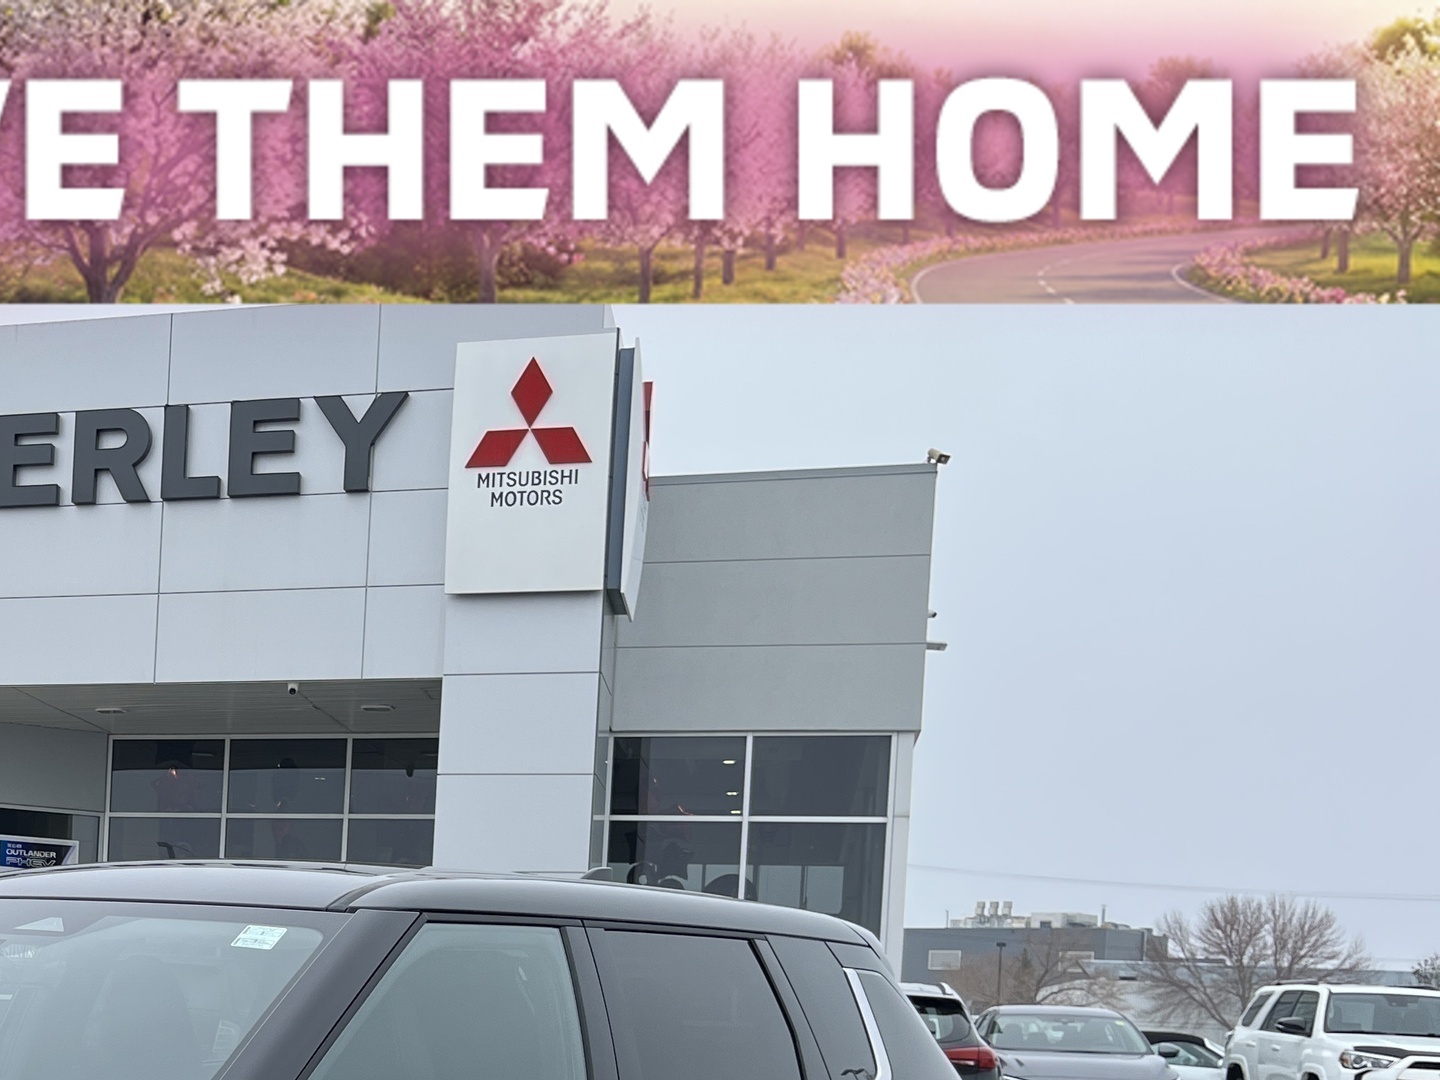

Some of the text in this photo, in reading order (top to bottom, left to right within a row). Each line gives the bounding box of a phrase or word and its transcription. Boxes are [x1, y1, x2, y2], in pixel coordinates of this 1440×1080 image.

[477, 468, 579, 489] MITSUBISHI
[490, 489, 563, 508] MOTORS
[6, 848, 57, 858] OUTLANDER
